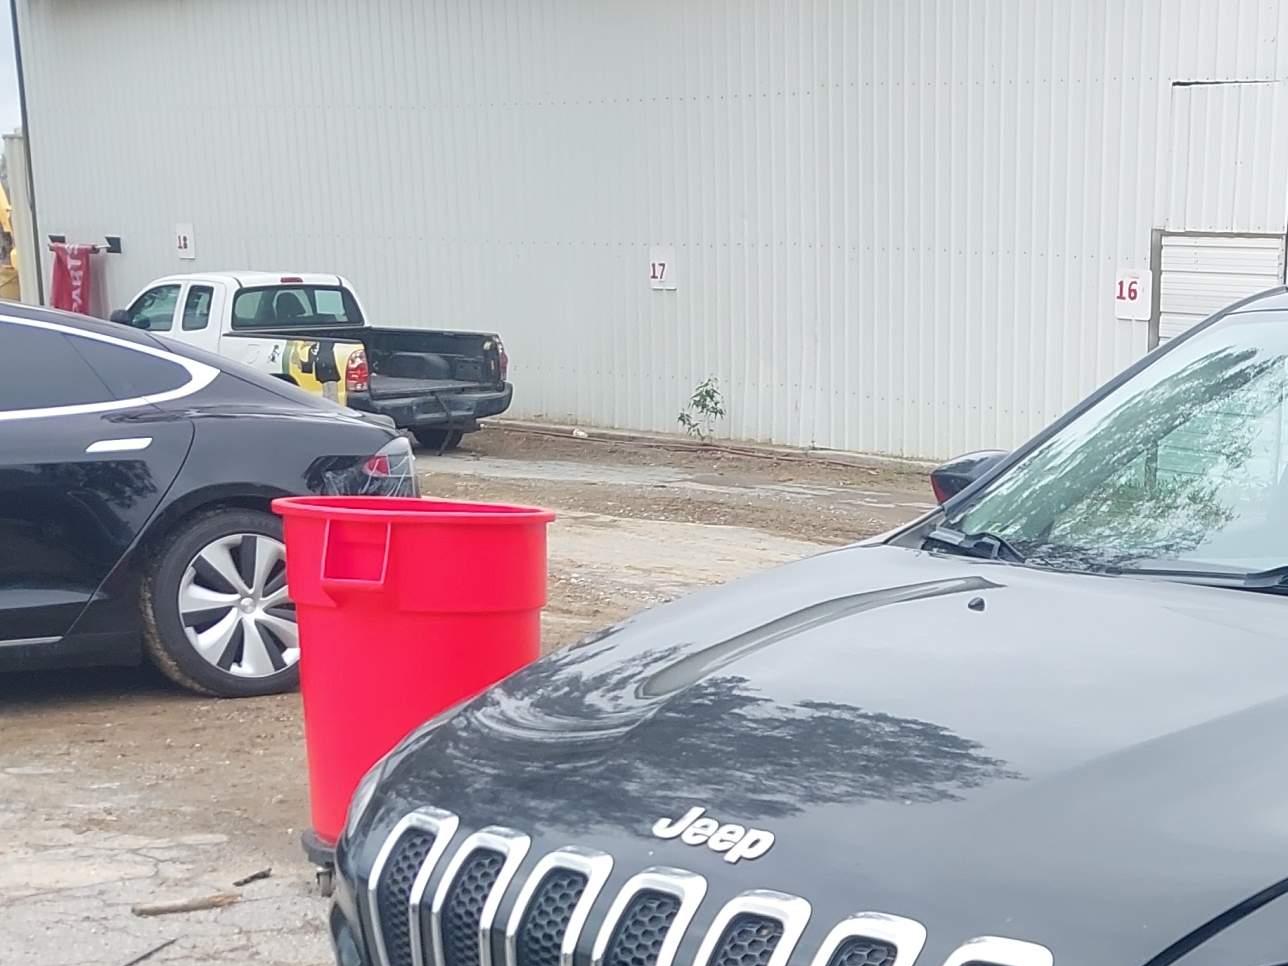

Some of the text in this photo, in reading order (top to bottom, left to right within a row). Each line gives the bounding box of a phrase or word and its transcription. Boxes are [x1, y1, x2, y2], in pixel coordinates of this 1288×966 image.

[650, 263, 666, 279] 17
[1116, 280, 1137, 301] 16
[652, 806, 776, 864] Jeep
